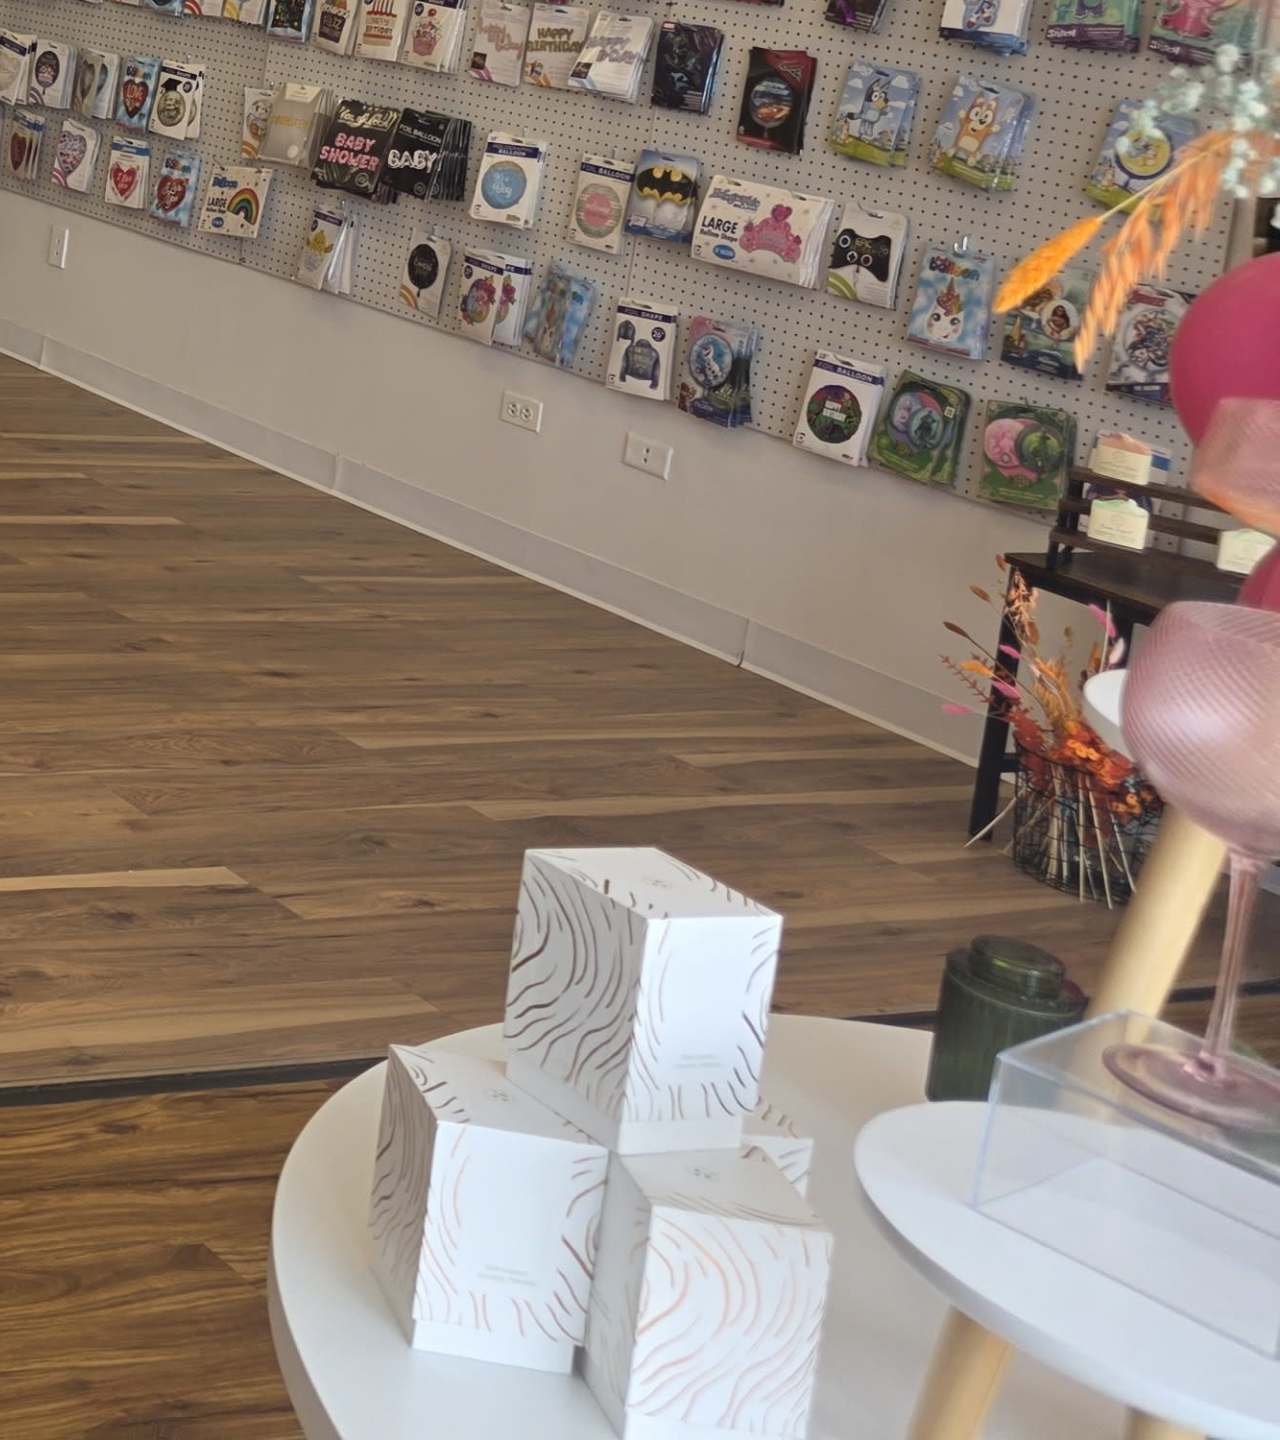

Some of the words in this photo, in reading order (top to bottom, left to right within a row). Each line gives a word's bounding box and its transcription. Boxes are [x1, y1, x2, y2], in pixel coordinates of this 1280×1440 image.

[537, 28, 574, 39] HAPPY
[334, 132, 377, 153] BABY
[319, 146, 381, 172] SHOWER
[388, 149, 438, 173] BABY
[598, 167, 631, 180] BALLOON
[208, 197, 228, 209] LARGE
[701, 215, 739, 234] LARGE
[836, 367, 873, 383] BALLOON
